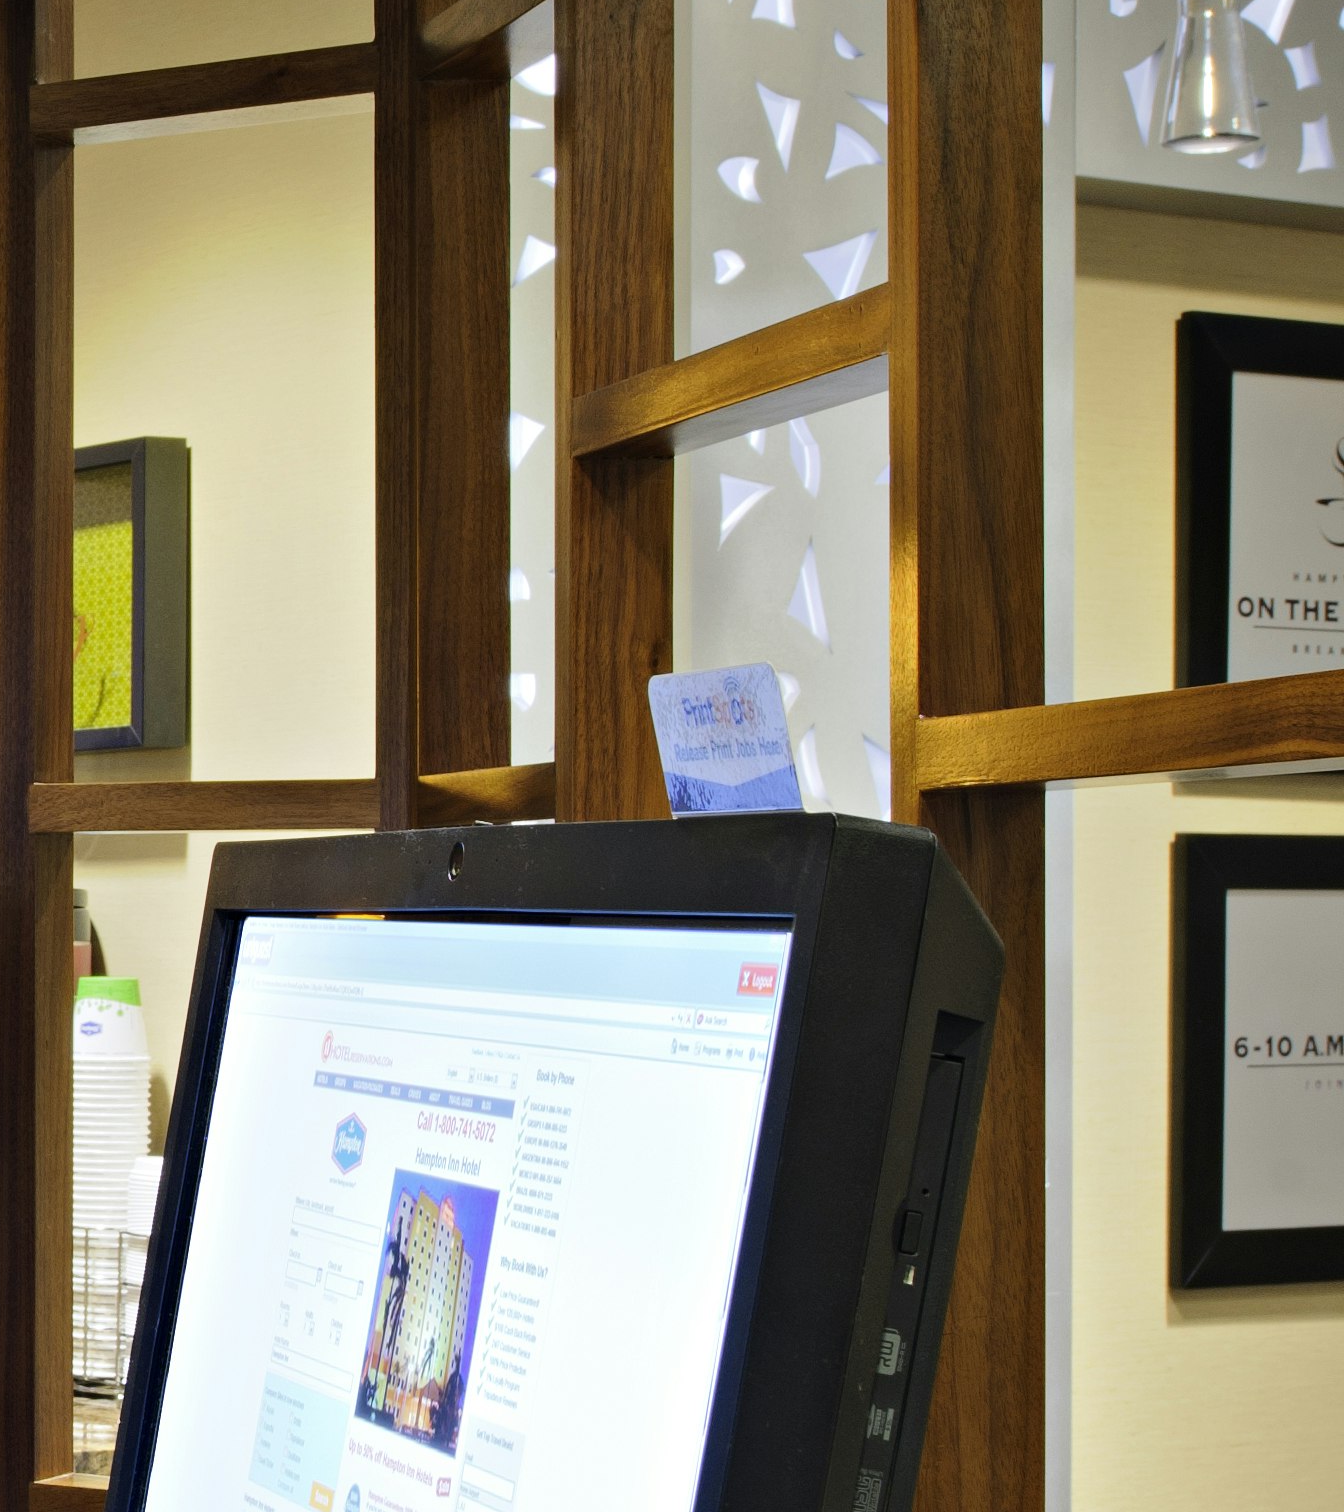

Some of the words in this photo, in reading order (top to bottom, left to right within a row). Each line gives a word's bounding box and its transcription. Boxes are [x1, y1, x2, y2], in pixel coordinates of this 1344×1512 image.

[1238, 597, 1274, 618] ON
[1285, 599, 1338, 622] THE
[673, 741, 709, 762] Release
[711, 740, 734, 759] Print
[736, 738, 757, 758] Jobs
[752, 972, 773, 991] Logout
[1234, 1035, 1293, 1059] 6-10
[558, 1072, 575, 1086] Phone
[418, 1110, 434, 1132] Call
[434, 1113, 497, 1143] 1-800-741-5072
[415, 1147, 448, 1171] Hampton
[449, 1154, 461, 1173] Inn
[462, 1156, 482, 1177] Hotel
[363, 1443, 374, 1461] 50%
[382, 1452, 406, 1475] Hampton
[415, 1465, 433, 1486] Hotels
